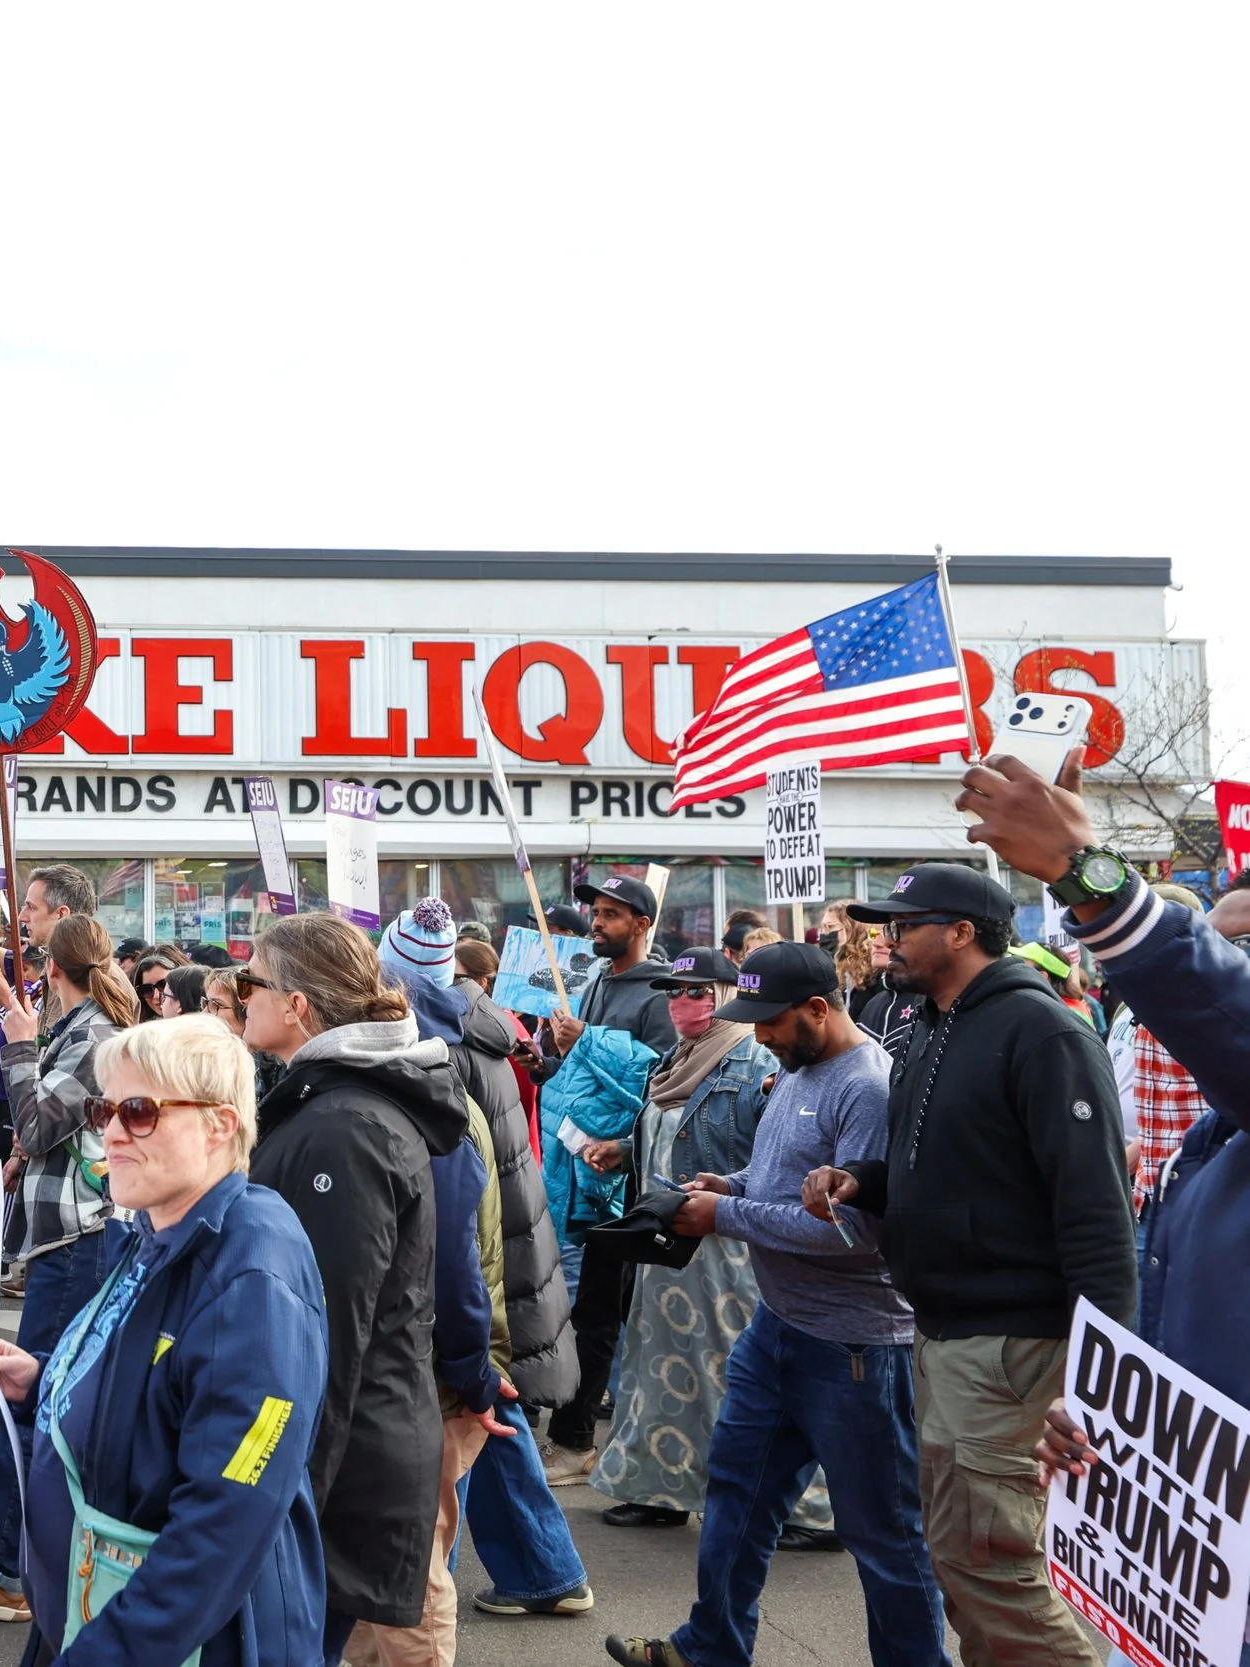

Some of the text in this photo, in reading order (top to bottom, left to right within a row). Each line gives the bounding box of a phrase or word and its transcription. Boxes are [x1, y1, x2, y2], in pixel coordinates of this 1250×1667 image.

[250, 781, 275, 807] SEIU
[767, 766, 819, 797] STUDENTS
[330, 785, 375, 816] SEIU
[767, 801, 817, 835] POWER
[766, 834, 820, 861] TO DEFEAT
[767, 865, 822, 899] TRUMP!
[1074, 1321, 1250, 1524] DOWN
[247, 1400, 294, 1488] 26.2 FINISHER
[1082, 1411, 1222, 1549] WITH
[1075, 1521, 1201, 1643] & THE
